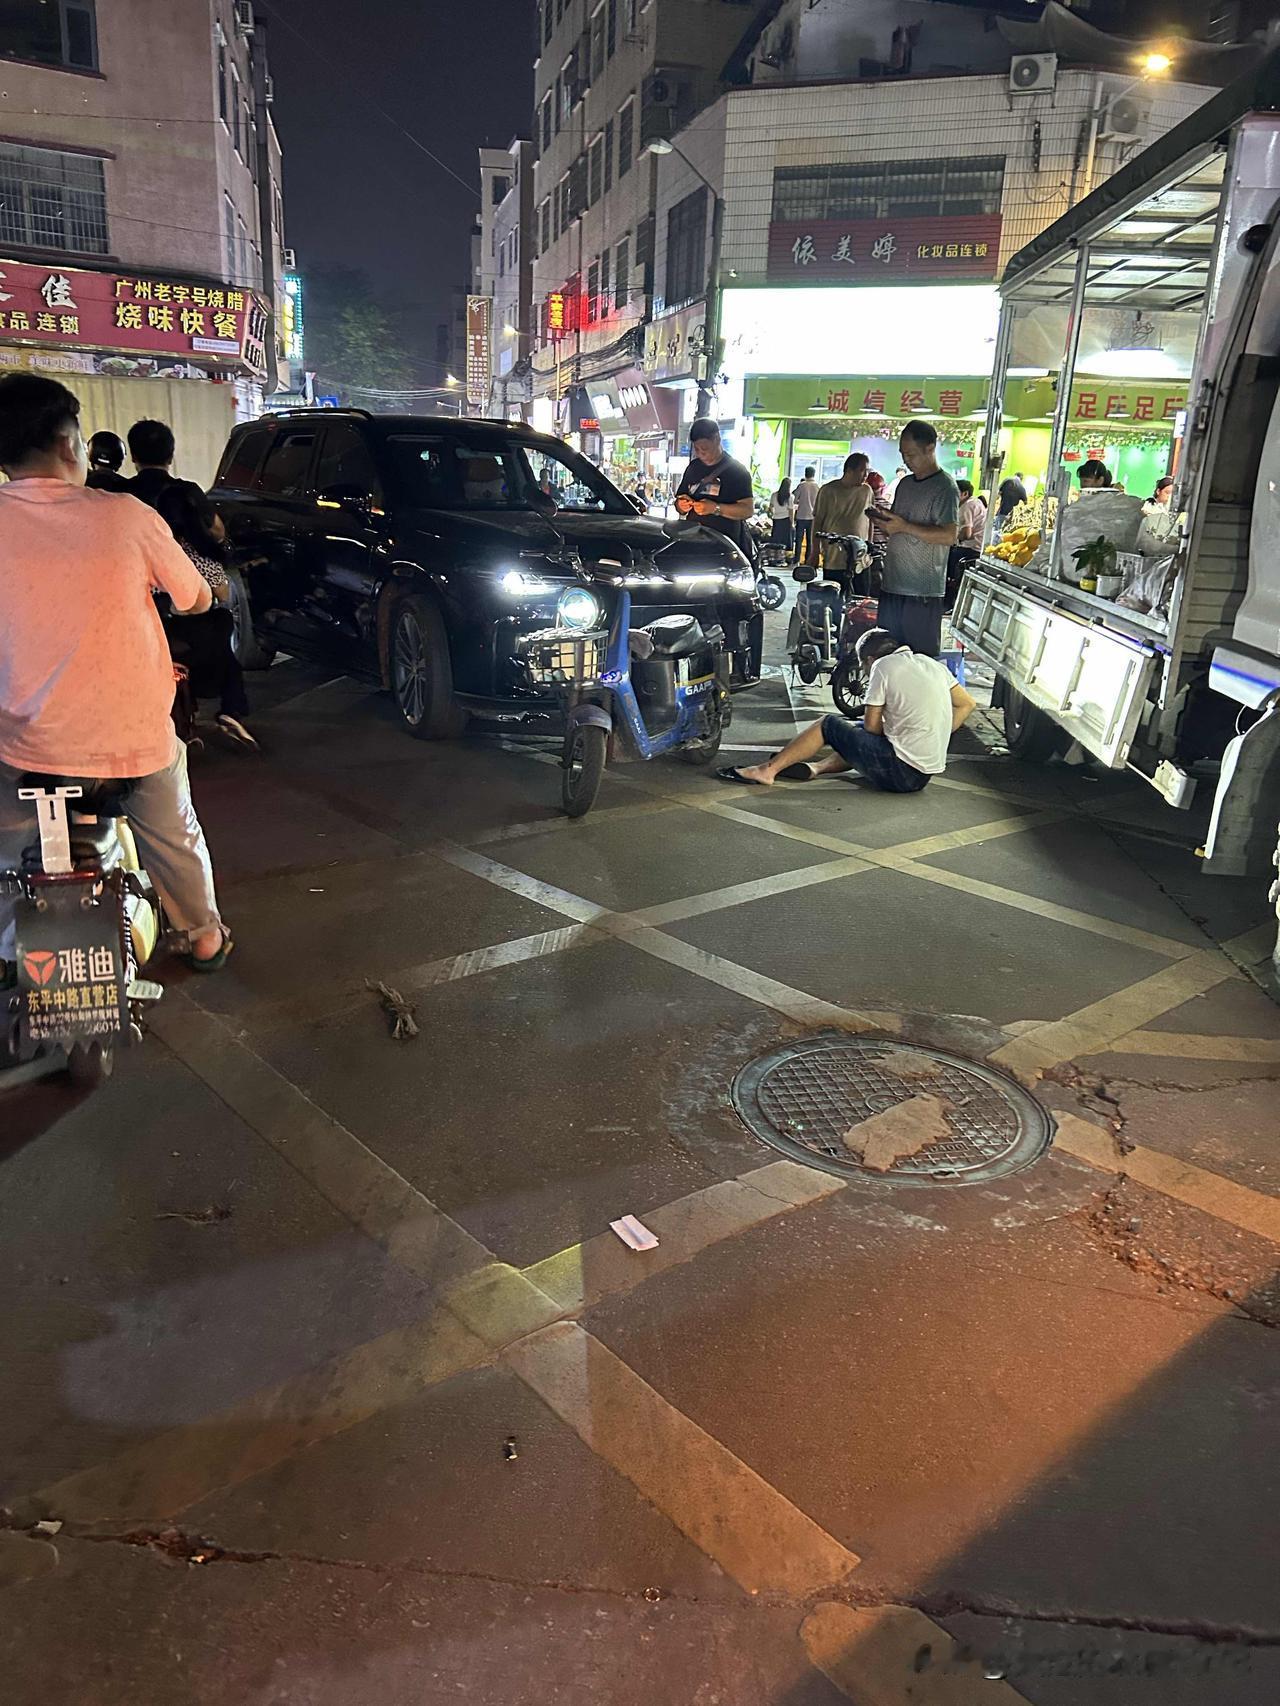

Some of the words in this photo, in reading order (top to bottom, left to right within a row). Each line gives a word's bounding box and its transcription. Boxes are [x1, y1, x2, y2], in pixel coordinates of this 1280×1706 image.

[791, 233, 899, 265] 依美婷
[916, 243, 988, 260] 化妆品连锁
[115, 279, 244, 312] 广州老字号烧腊
[116, 302, 238, 339] 烧味快餐
[827, 389, 963, 415] 诚信经营
[58, 946, 116, 983] 雅迪
[27, 983, 118, 1013] 东平中路直营店
